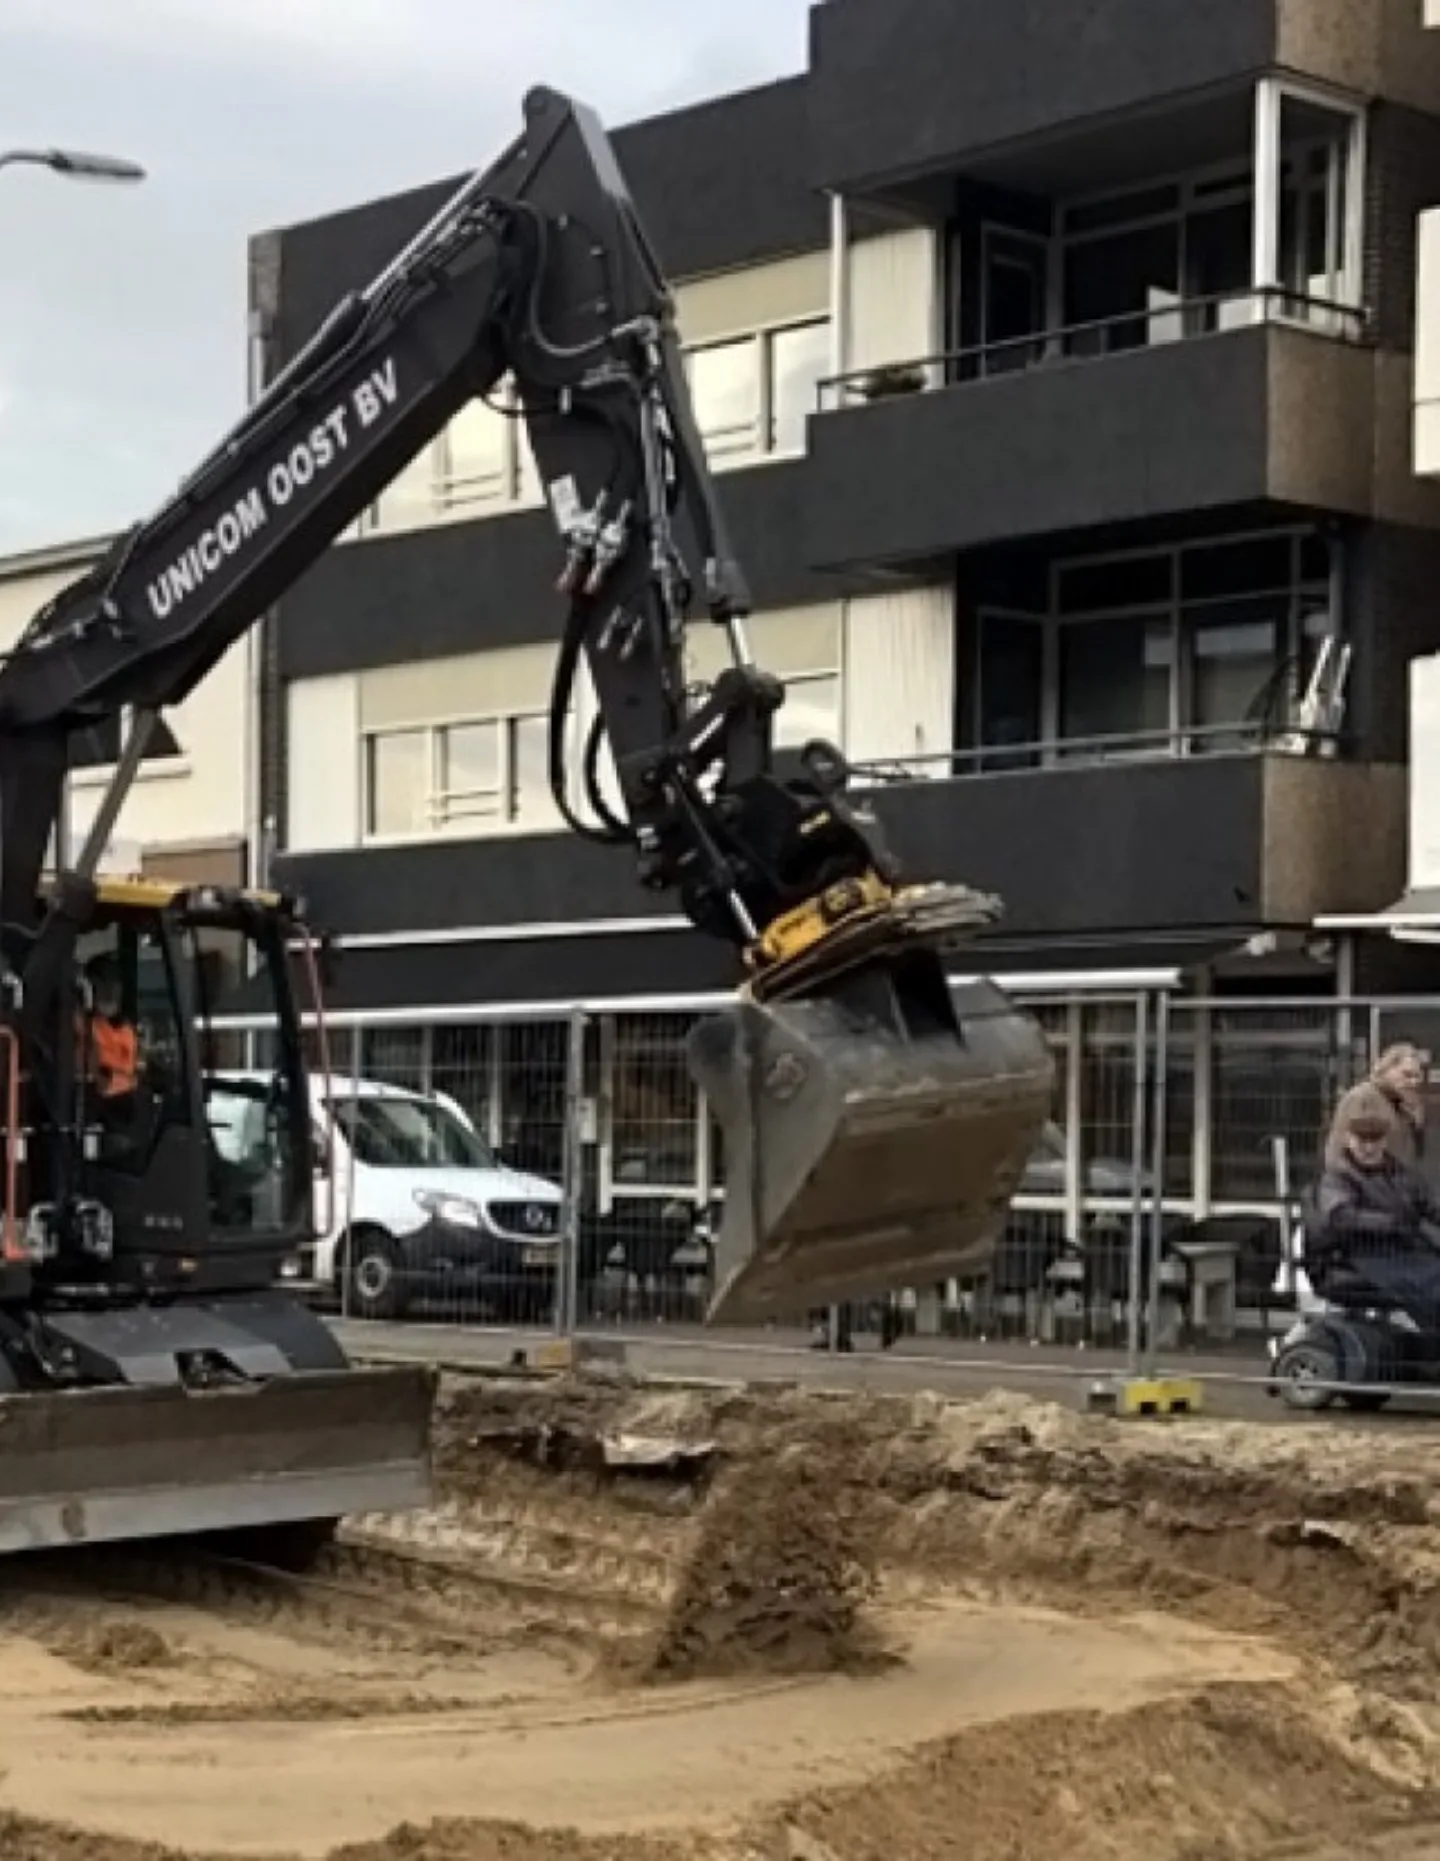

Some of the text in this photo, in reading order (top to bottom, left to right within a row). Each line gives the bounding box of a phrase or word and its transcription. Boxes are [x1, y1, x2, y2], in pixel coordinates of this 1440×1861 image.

[147, 356, 397, 619] UNICOM OOST BV
